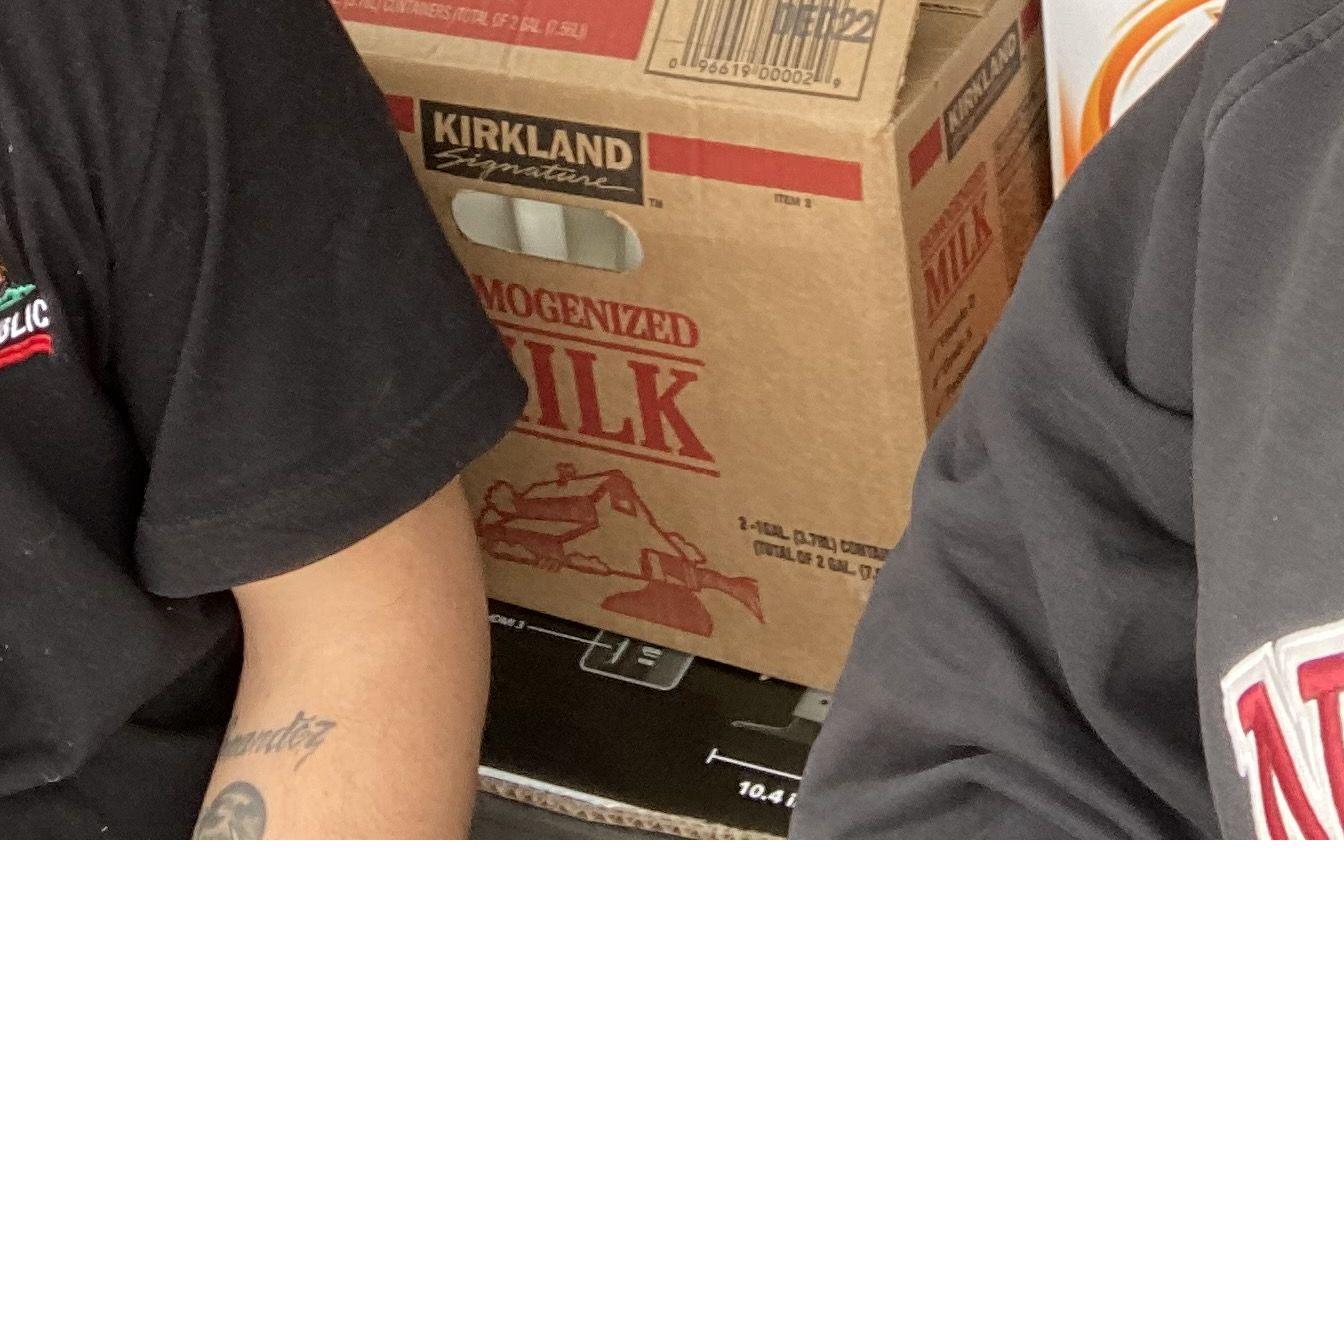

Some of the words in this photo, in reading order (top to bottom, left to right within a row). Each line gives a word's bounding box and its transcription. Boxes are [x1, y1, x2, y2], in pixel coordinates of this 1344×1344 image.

[669, 58, 677, 69] 0
[698, 59, 751, 78] 96619
[757, 62, 813, 85] 00002
[832, 77, 842, 89] 9
[433, 110, 633, 171] KIRKLAND
[425, 144, 635, 192] Signature
[473, 272, 701, 351] MOGENIZED
[738, 780, 784, 806] 10.4
